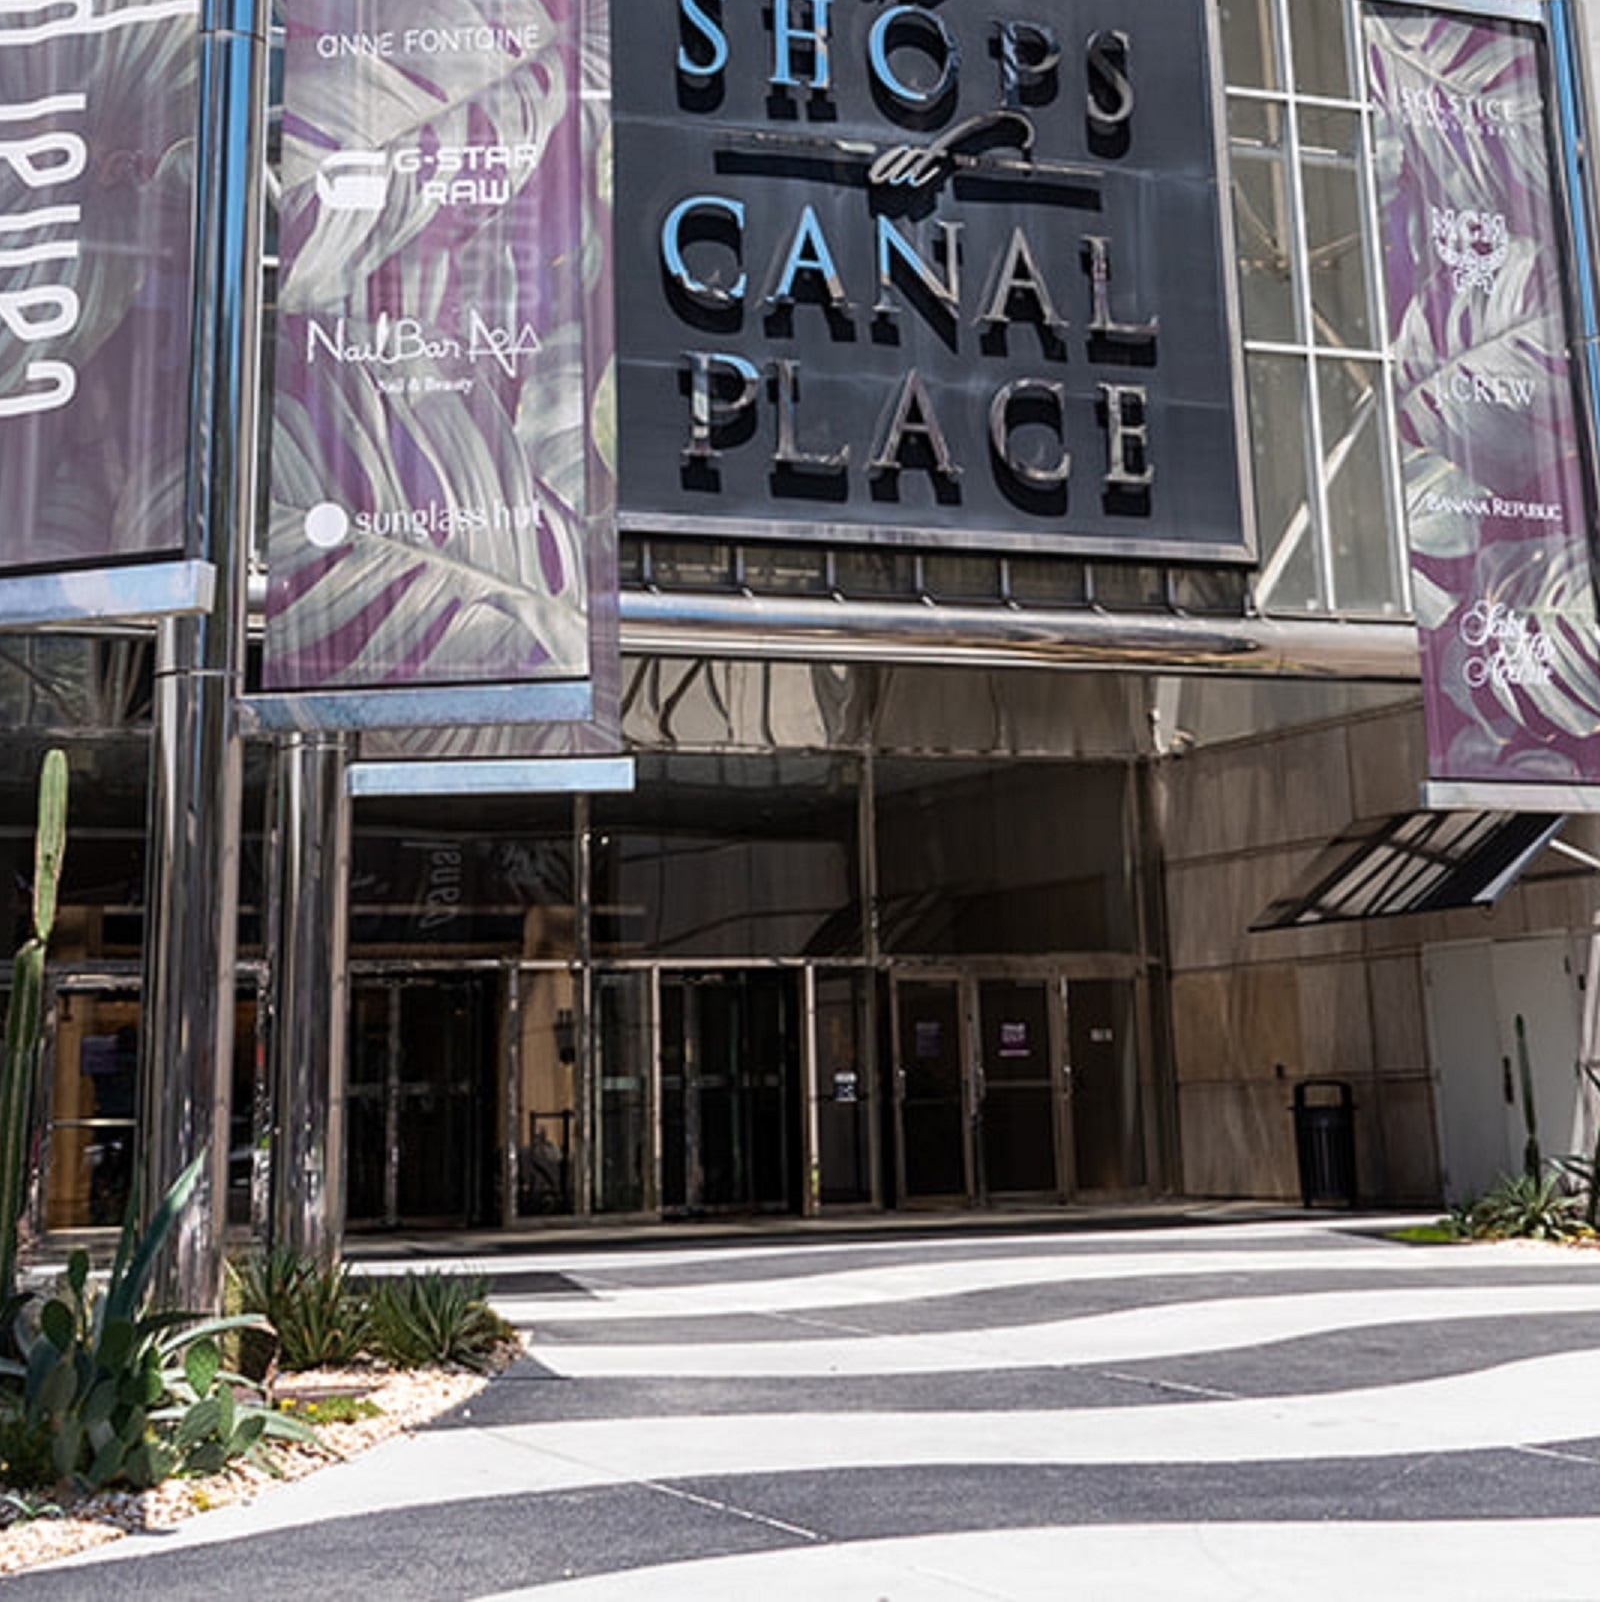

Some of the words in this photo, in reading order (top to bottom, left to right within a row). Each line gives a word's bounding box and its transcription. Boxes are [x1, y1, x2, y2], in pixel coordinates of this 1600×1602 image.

[394, 143, 538, 174] G-STAR
[422, 178, 511, 206] RAW
[660, 195, 1161, 339] CANAL
[679, 350, 1157, 487] PLACE
[355, 500, 488, 542] sunglass
[492, 498, 545, 530] hut
